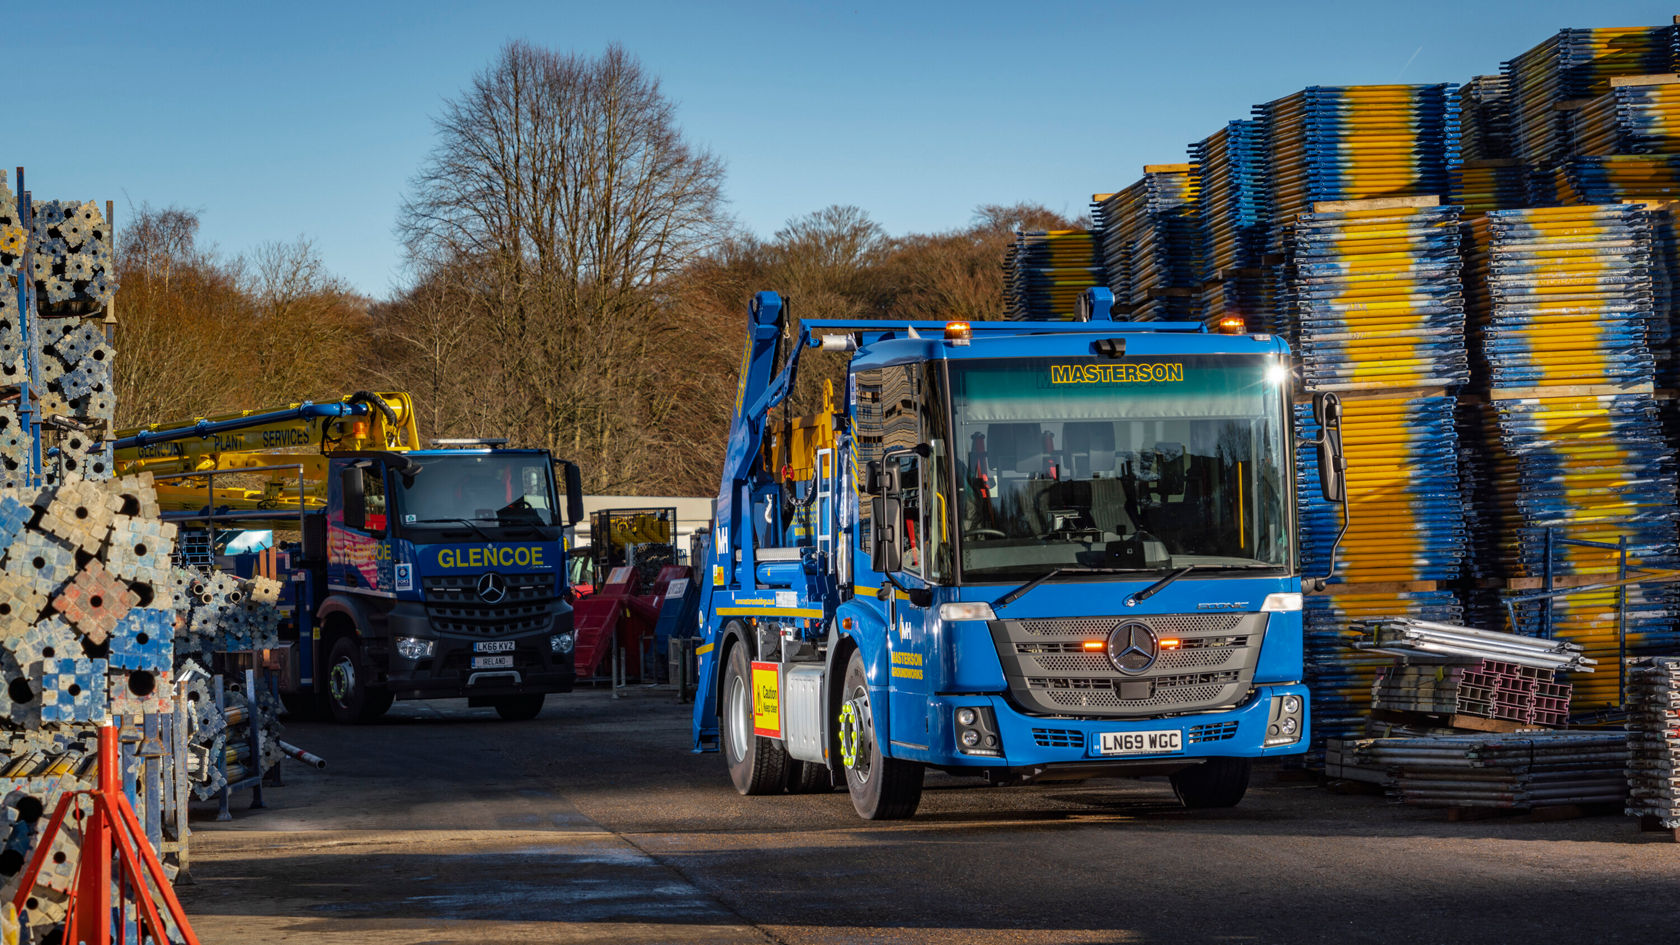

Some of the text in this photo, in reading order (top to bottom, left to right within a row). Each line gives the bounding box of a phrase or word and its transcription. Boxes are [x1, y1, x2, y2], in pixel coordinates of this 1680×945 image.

[1051, 362, 1184, 384] MASTERSON
[214, 434, 244, 452] PLANT
[263, 428, 310, 448] SERVICES
[438, 547, 544, 568] GLENCOE
[477, 642, 513, 651] LK66 KVZ
[482, 657, 506, 666] IRELAND
[891, 651, 923, 667] MASTERSON
[763, 685, 777, 700] Caution
[1103, 733, 1179, 751] LN69 WGC
